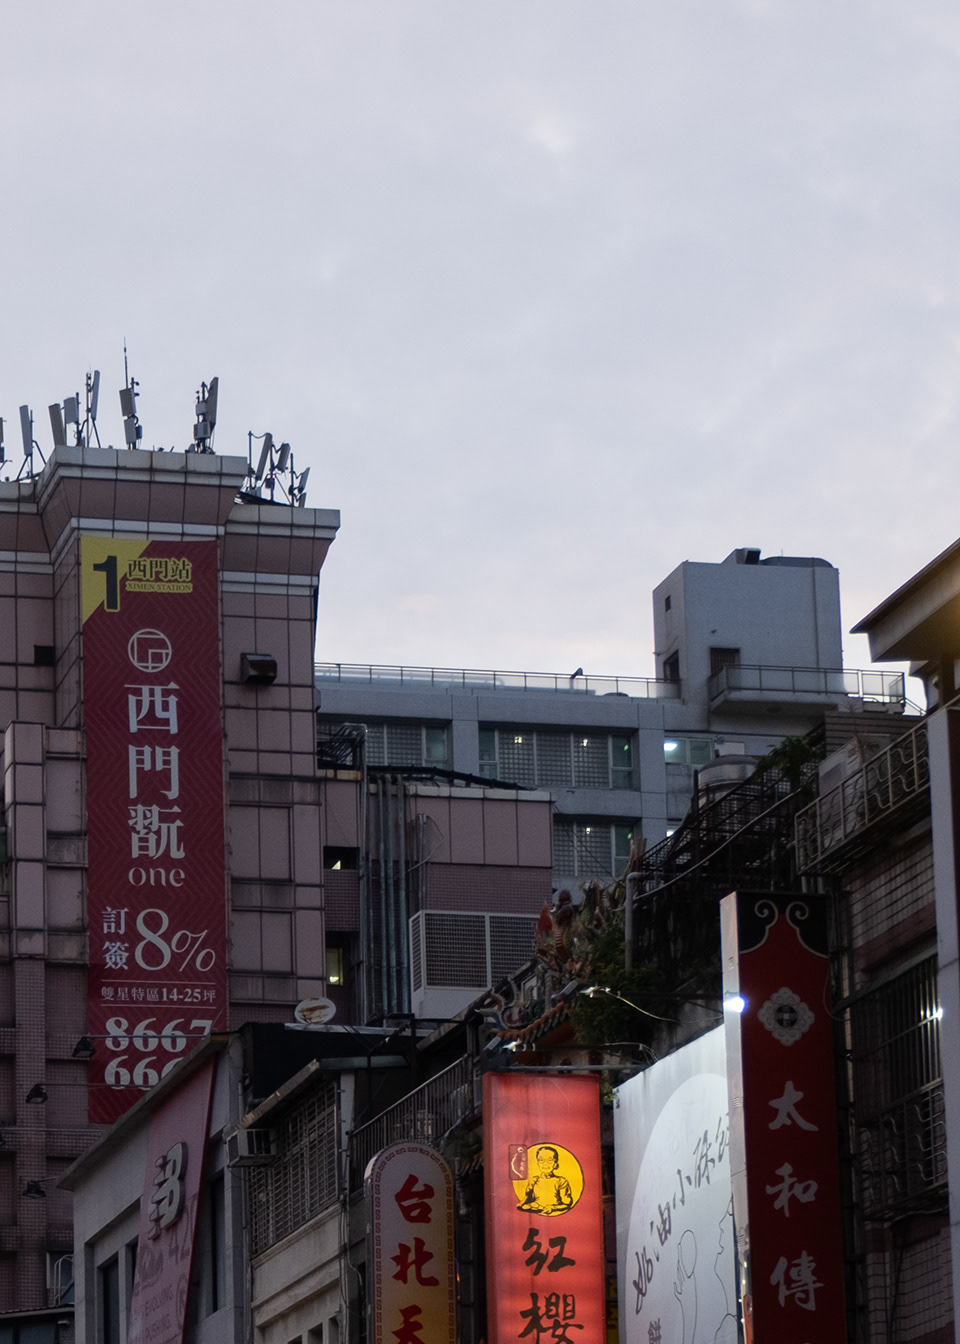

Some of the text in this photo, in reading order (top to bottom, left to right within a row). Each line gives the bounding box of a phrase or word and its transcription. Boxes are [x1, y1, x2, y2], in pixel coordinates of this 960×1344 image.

[93, 556, 118, 610] 1
[127, 558, 191, 581] 西門站
[126, 582, 191, 592] XIMEN STATION
[128, 867, 186, 888] one
[101, 906, 130, 971] 訂簽
[134, 908, 216, 972] 8%
[101, 987, 216, 1003] 雙星特區14-25坪
[105, 1017, 213, 1052] 8667
